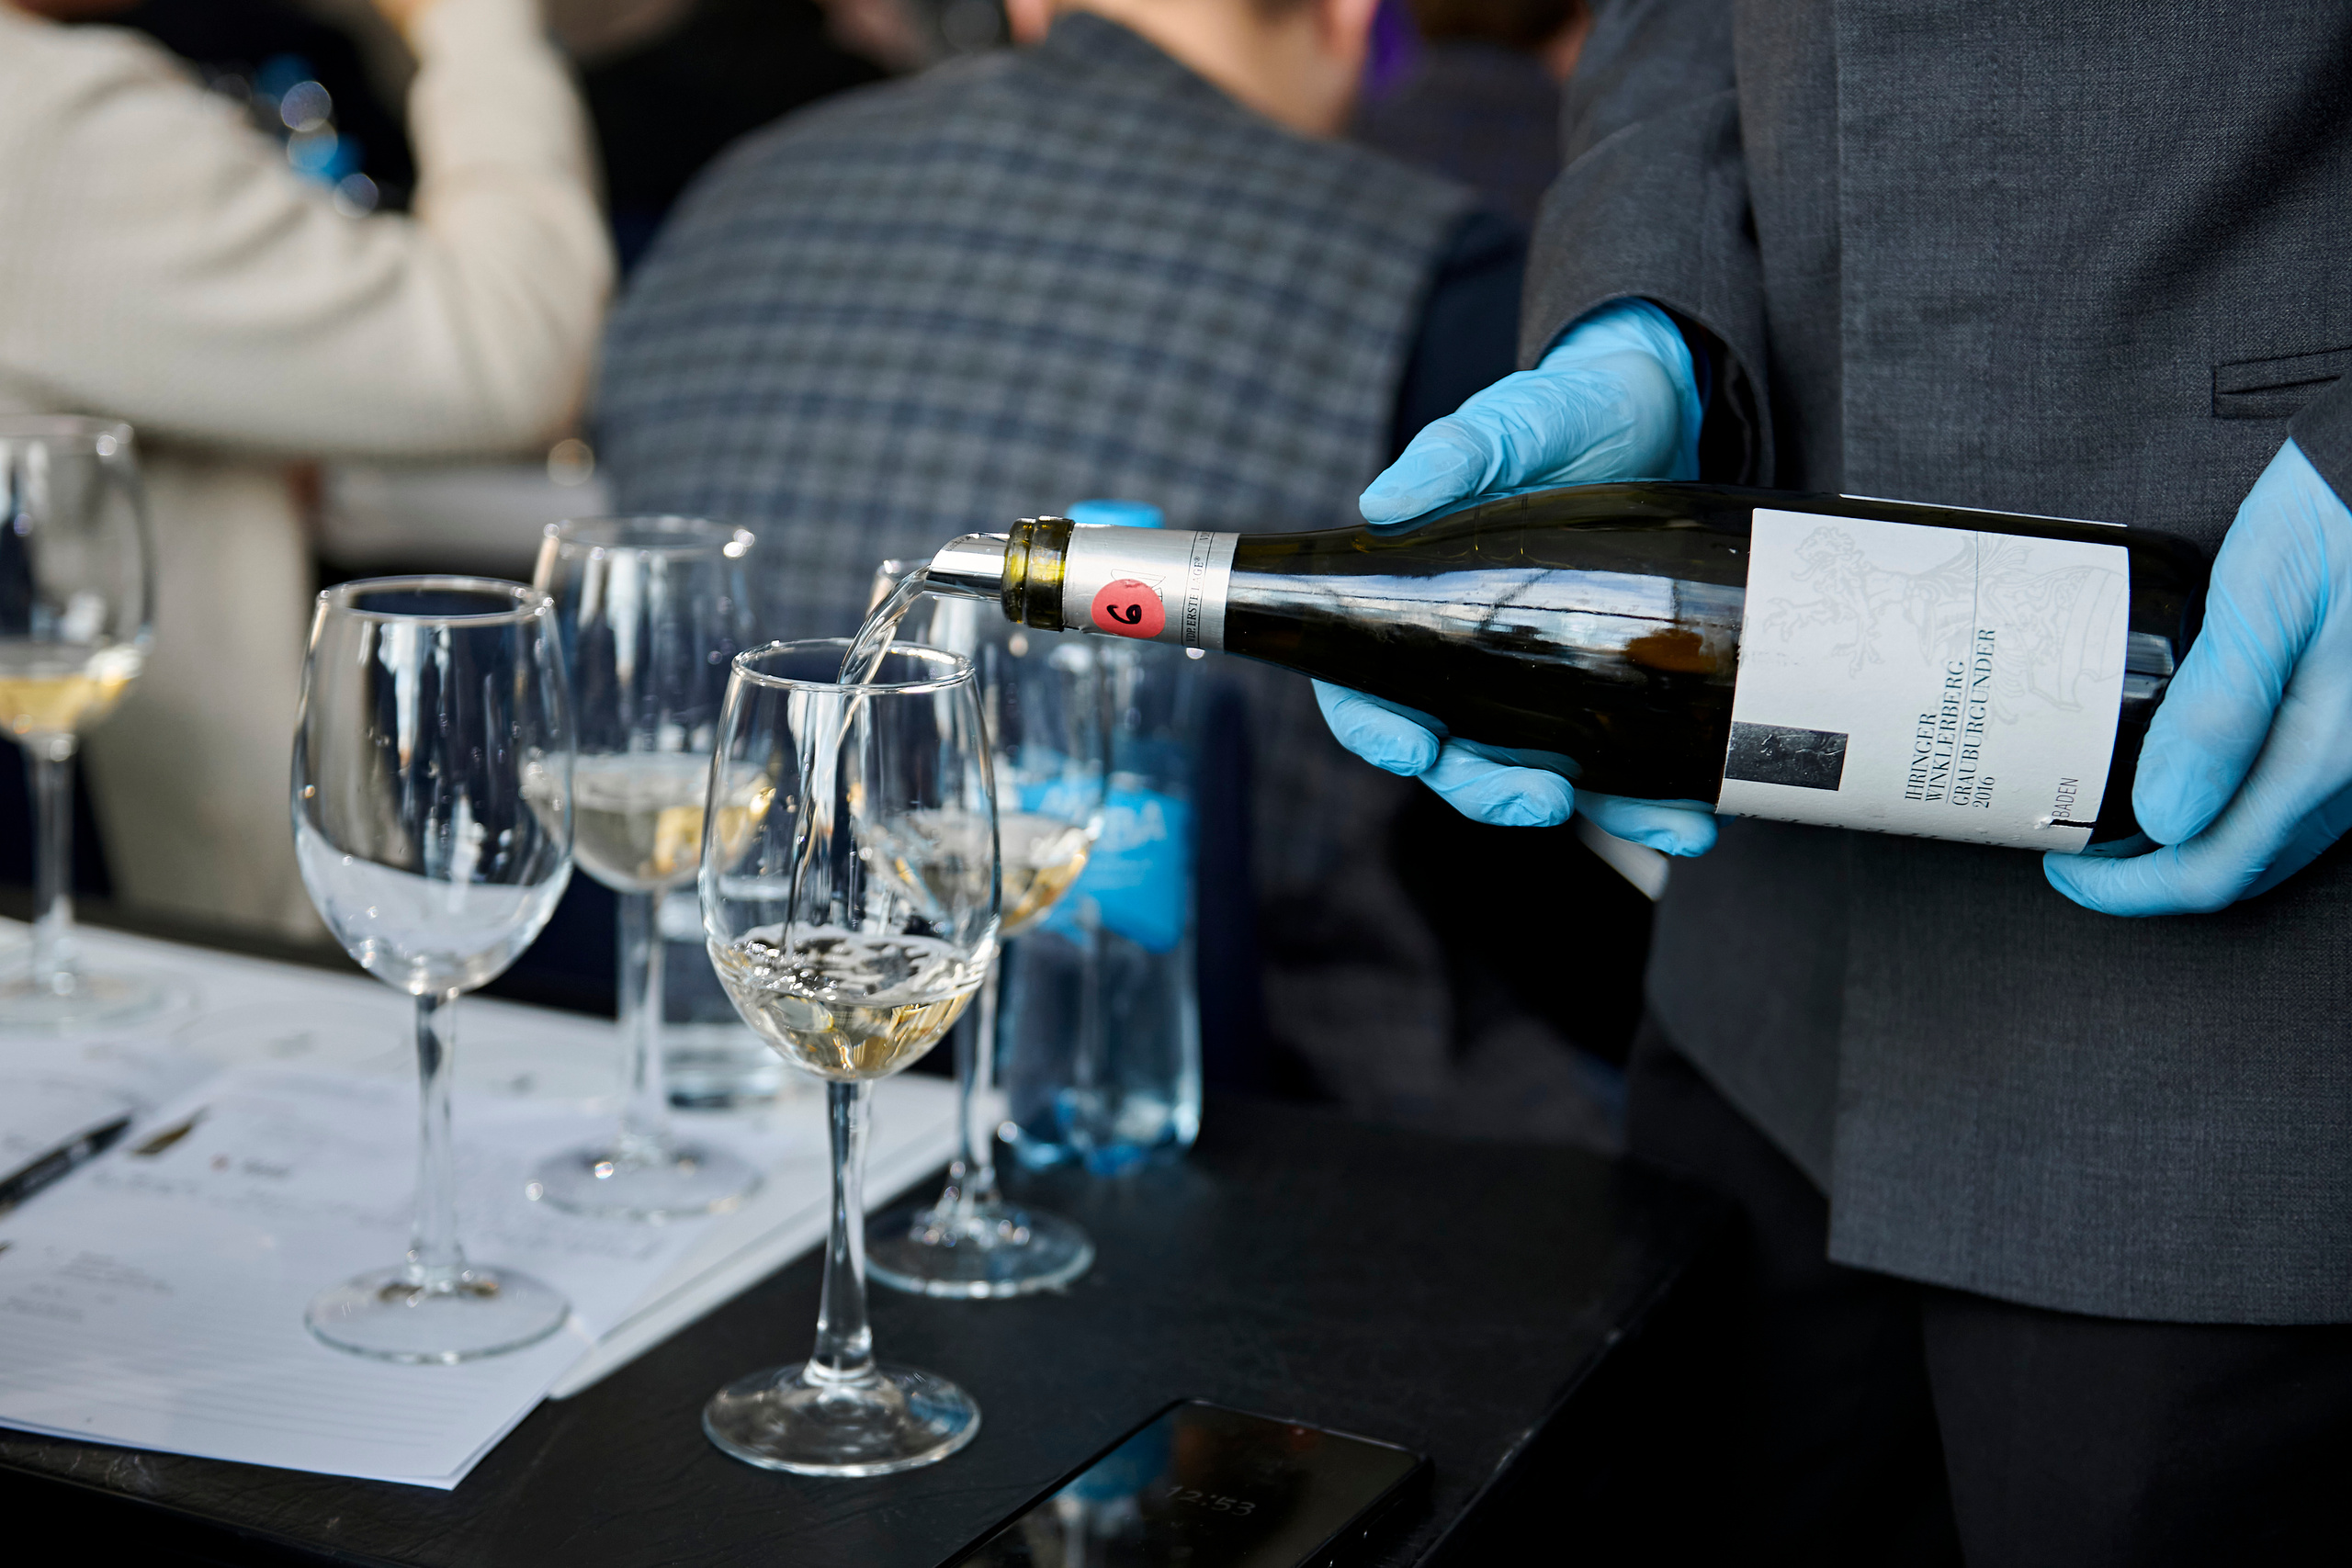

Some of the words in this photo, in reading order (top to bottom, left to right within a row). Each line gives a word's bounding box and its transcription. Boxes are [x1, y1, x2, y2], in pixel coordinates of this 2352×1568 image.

[1106, 604, 1142, 625] 6
[1186, 593, 1199, 626] ERSTE
[1925, 660, 1964, 802] WINKLERBERG
[1951, 629, 1996, 806] GRAUBURGUNDER
[1905, 713, 1937, 800] IHRINGER
[1973, 777, 1995, 808] 2016
[2052, 778, 2078, 818] BADEN
[1165, 1485, 1256, 1516] 12:53
